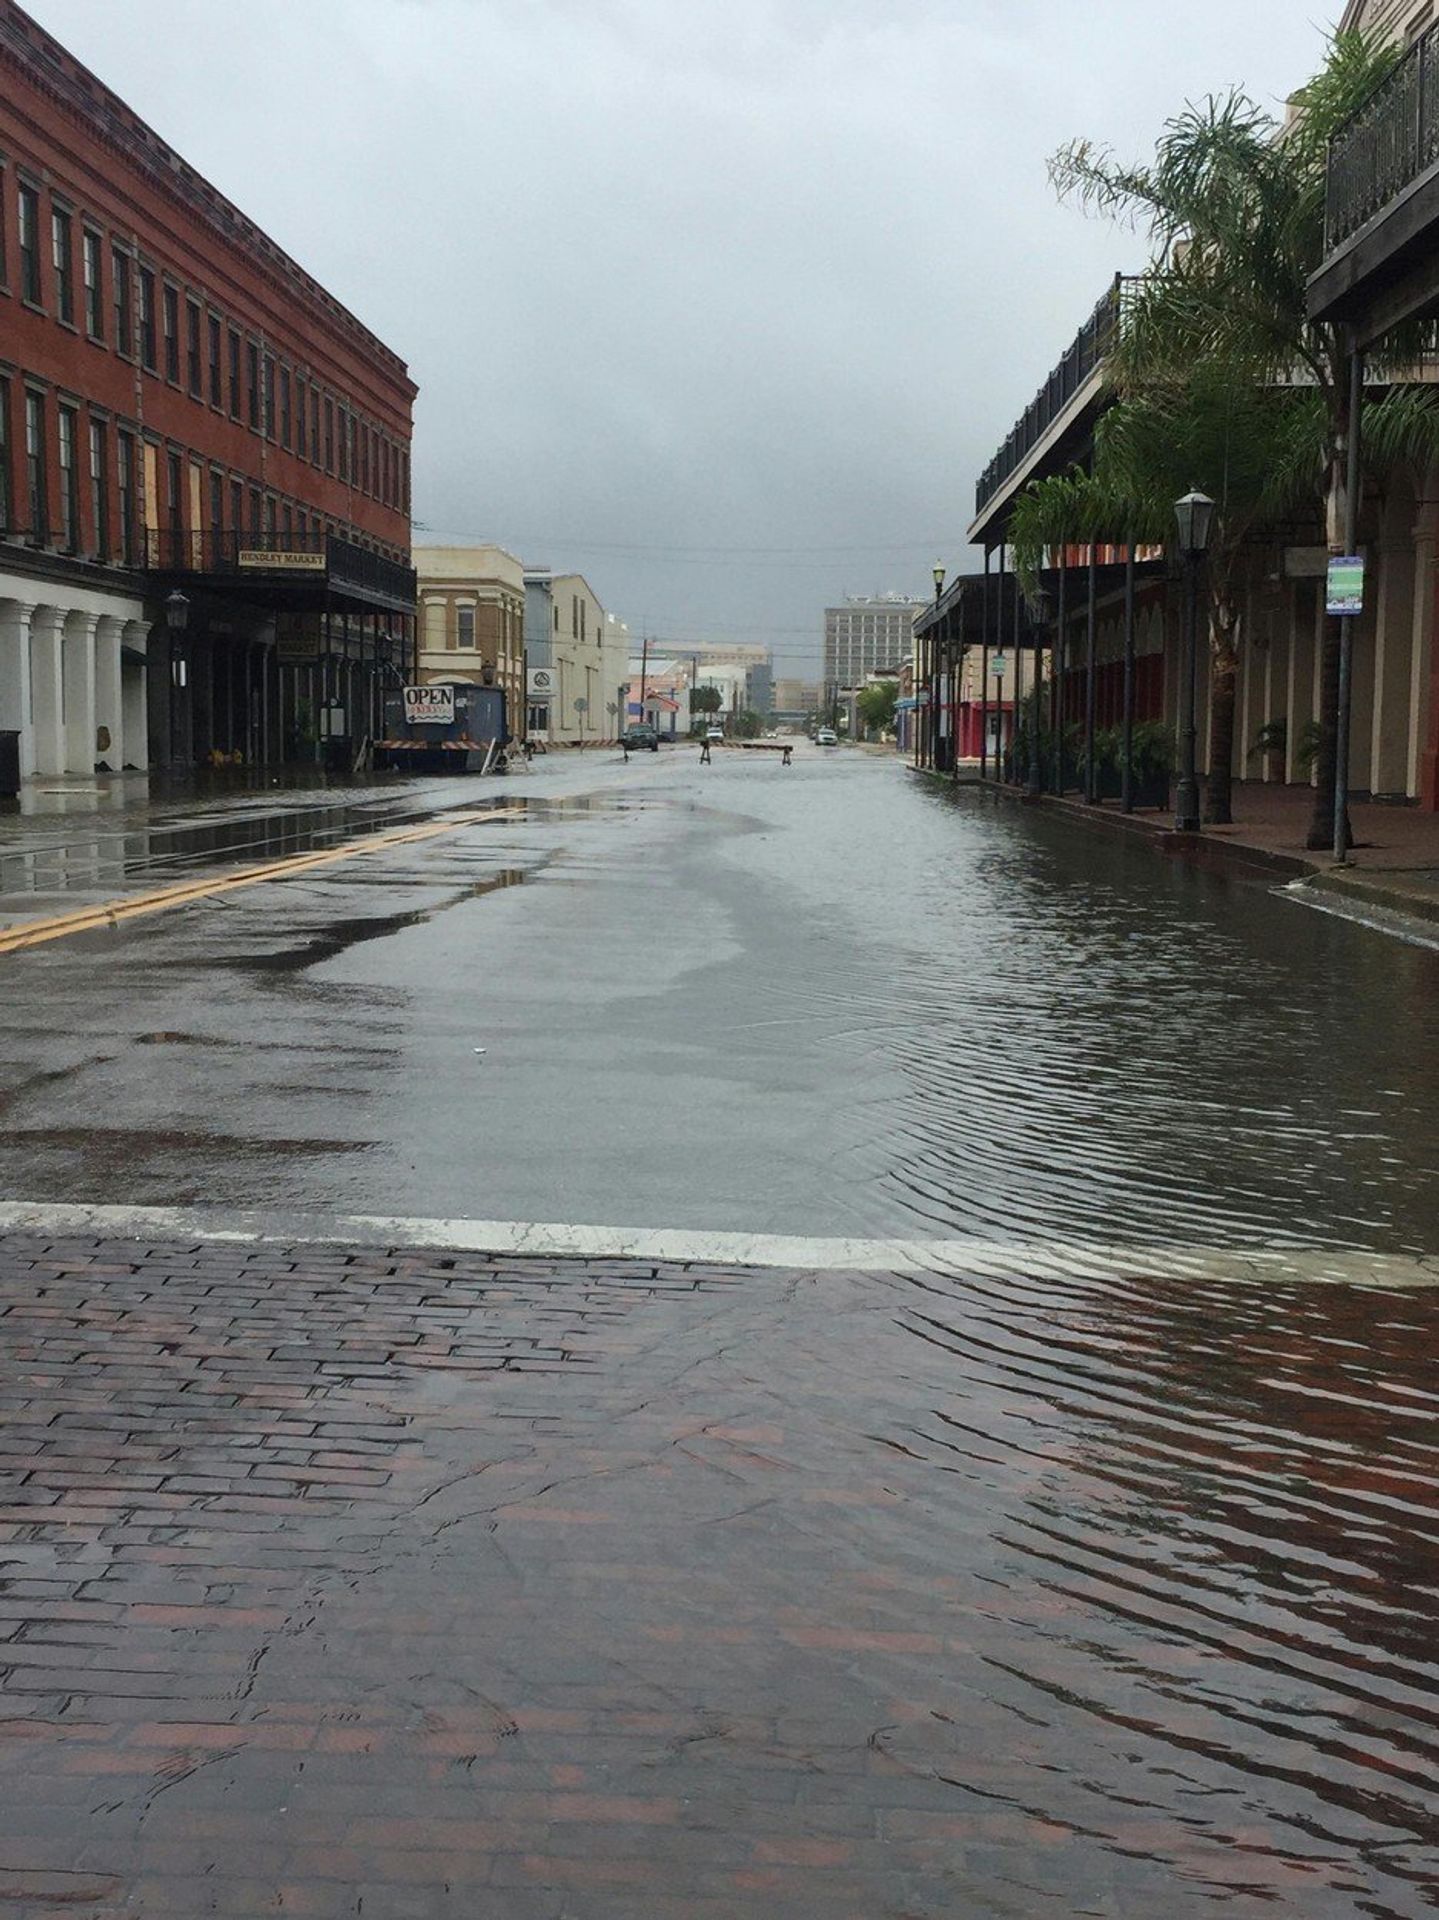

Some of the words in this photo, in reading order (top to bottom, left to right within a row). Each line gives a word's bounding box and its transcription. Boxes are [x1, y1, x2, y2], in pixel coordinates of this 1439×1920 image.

[241, 552, 281, 562] HENDLEY
[284, 554, 323, 564] MARKET
[406, 688, 453, 704] OPEN
